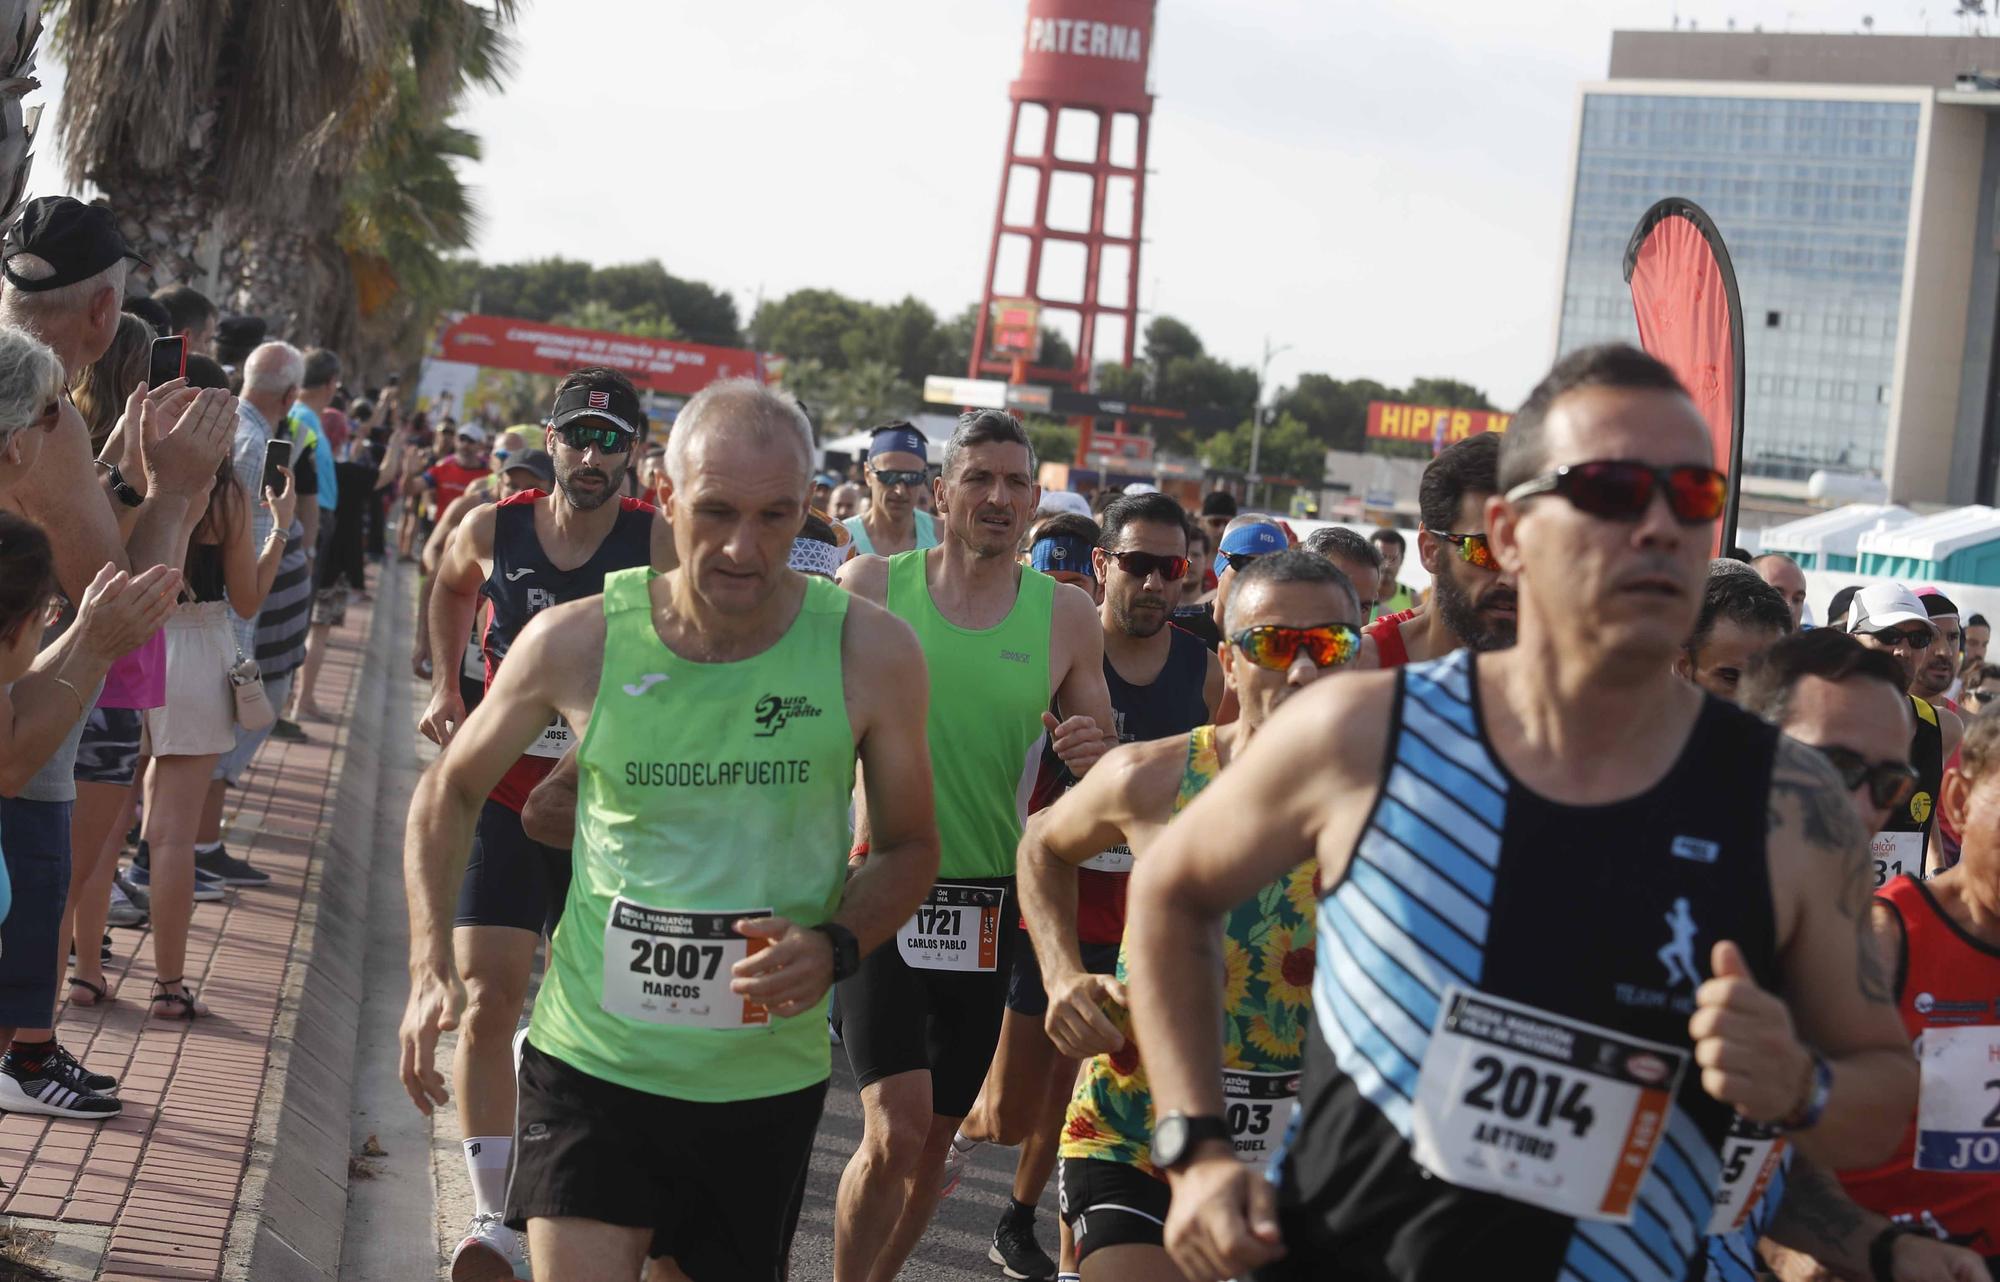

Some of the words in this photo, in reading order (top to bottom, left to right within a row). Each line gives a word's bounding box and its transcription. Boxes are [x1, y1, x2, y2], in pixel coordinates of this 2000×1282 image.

[1029, 16, 1140, 63] PATERNA
[1380, 404, 1471, 441] HIPER
[544, 730, 568, 741] JOSE
[625, 760, 811, 787] SUSODELAFUENTE
[916, 907, 962, 936] 1721
[629, 938, 724, 980] 2007
[908, 938, 938, 949] CARLOS
[940, 939, 967, 951] PABLO
[643, 981, 701, 999] MARCOS
[1464, 1054, 1596, 1138] 2014
[1227, 1103, 1273, 1135] 03
[1234, 1140, 1266, 1151] GUEL
